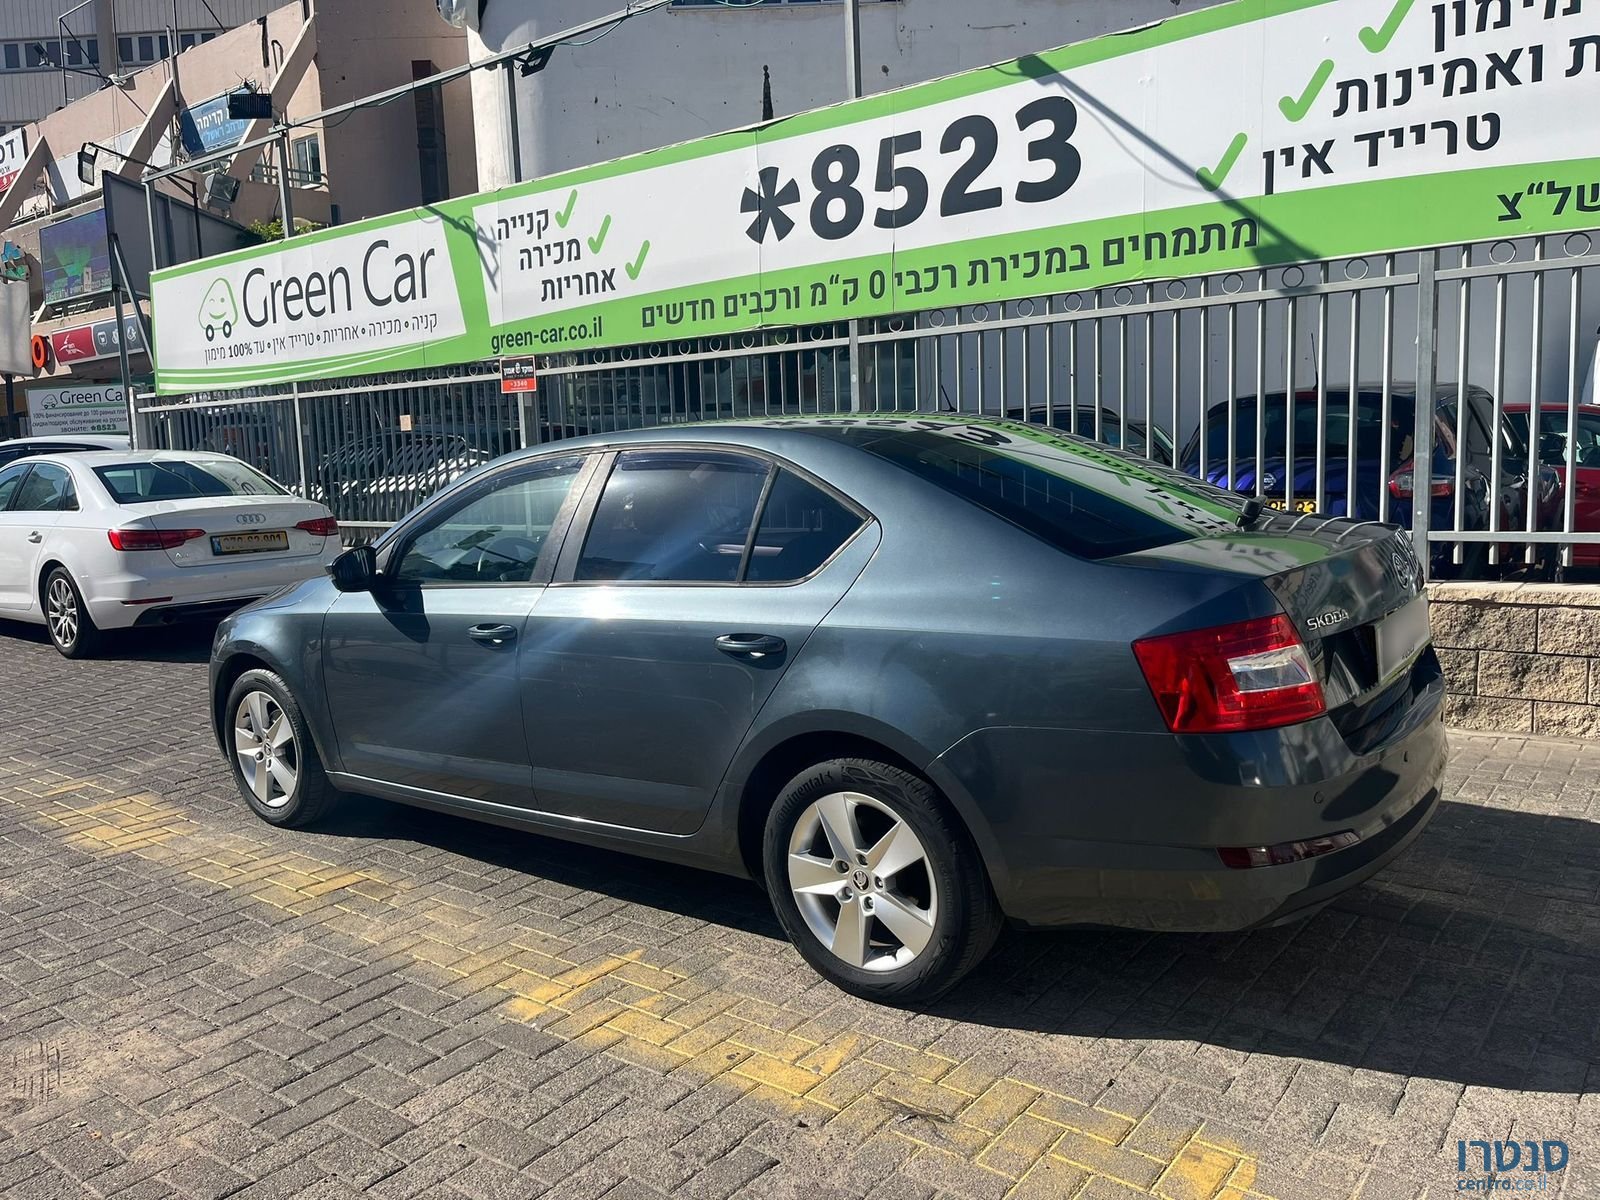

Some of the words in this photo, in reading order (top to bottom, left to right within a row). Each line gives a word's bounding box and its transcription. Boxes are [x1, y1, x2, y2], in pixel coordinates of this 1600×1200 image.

[1333, 44, 1543, 117] ואמינות
[1354, 111, 1500, 167] טרייד
[1263, 138, 1335, 195] אין
[498, 209, 549, 240] קנייה
[520, 238, 581, 270] מכירה
[1103, 217, 1257, 266] מתמחים
[895, 264, 956, 295] רכבי
[968, 245, 1089, 286] במכירת
[243, 267, 352, 328] Green
[363, 239, 435, 306] Car
[542, 268, 616, 301] אחריות
[869, 270, 885, 299] 0
[642, 299, 714, 327] חדשים
[724, 286, 800, 317] ורכבים
[323, 325, 359, 344] אחריות
[369, 318, 402, 337] מכירה
[412, 313, 437, 332] קניה
[491, 316, 603, 354] green-car.co.il
[229, 342, 252, 357] 100%
[254, 340, 265, 353] עד
[273, 337, 286, 354] אין
[288, 332, 314, 348] טרייד
[205, 347, 225, 365] מימון
[60, 390, 101, 404] Green
[105, 388, 123, 402] Ca
